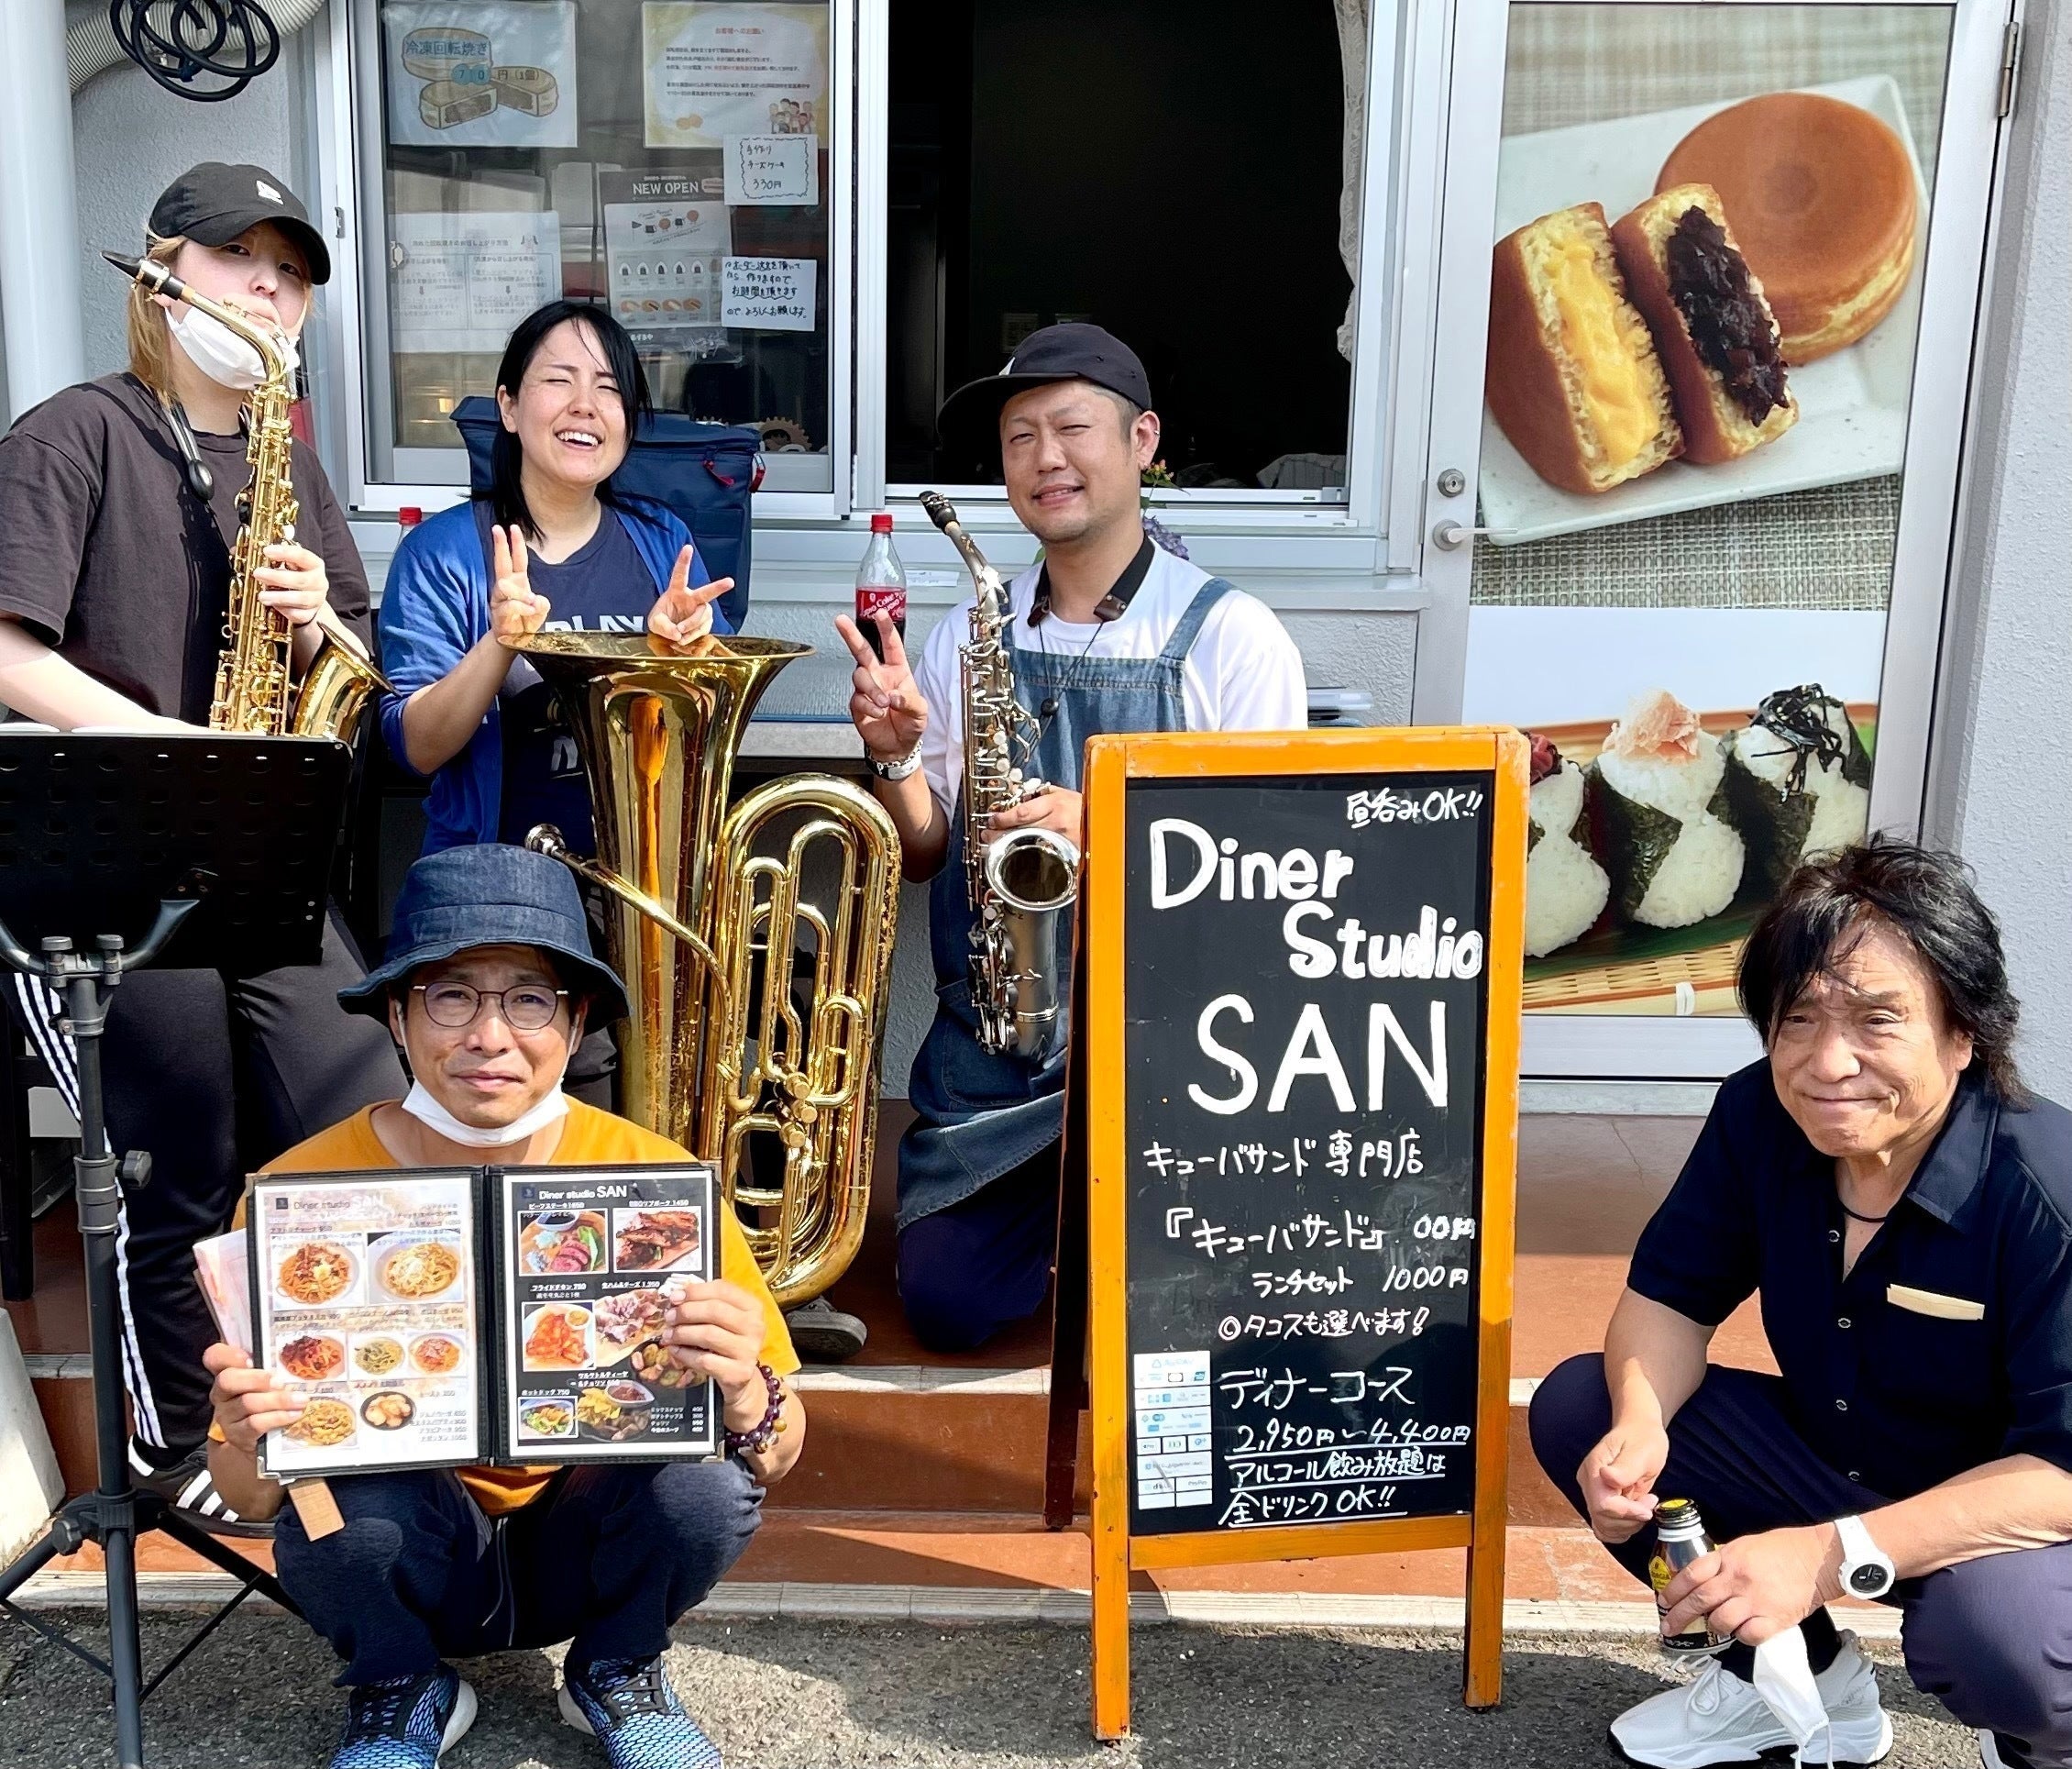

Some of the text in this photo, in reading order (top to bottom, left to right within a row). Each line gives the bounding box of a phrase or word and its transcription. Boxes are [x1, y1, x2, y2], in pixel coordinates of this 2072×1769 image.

[404, 40, 488, 56] 冷凍回転焼き
[633, 182, 699, 195] NEW OPEN
[752, 178, 782, 190] 330円
[1149, 817, 1354, 910] Diner
[1283, 900, 1483, 979] Studio
[1187, 993, 1449, 1115] SAN
[1143, 1128, 1424, 1179] キューバサンド 専門店
[293, 1201, 318, 1210] Diner
[539, 1185, 628, 1200] Diner studio SAN
[1251, 1265, 1470, 1299] ランチセット 1000円
[1219, 1366, 1416, 1410] ディナーコース
[1228, 1445, 1447, 1488] アルコール飲み放題は
